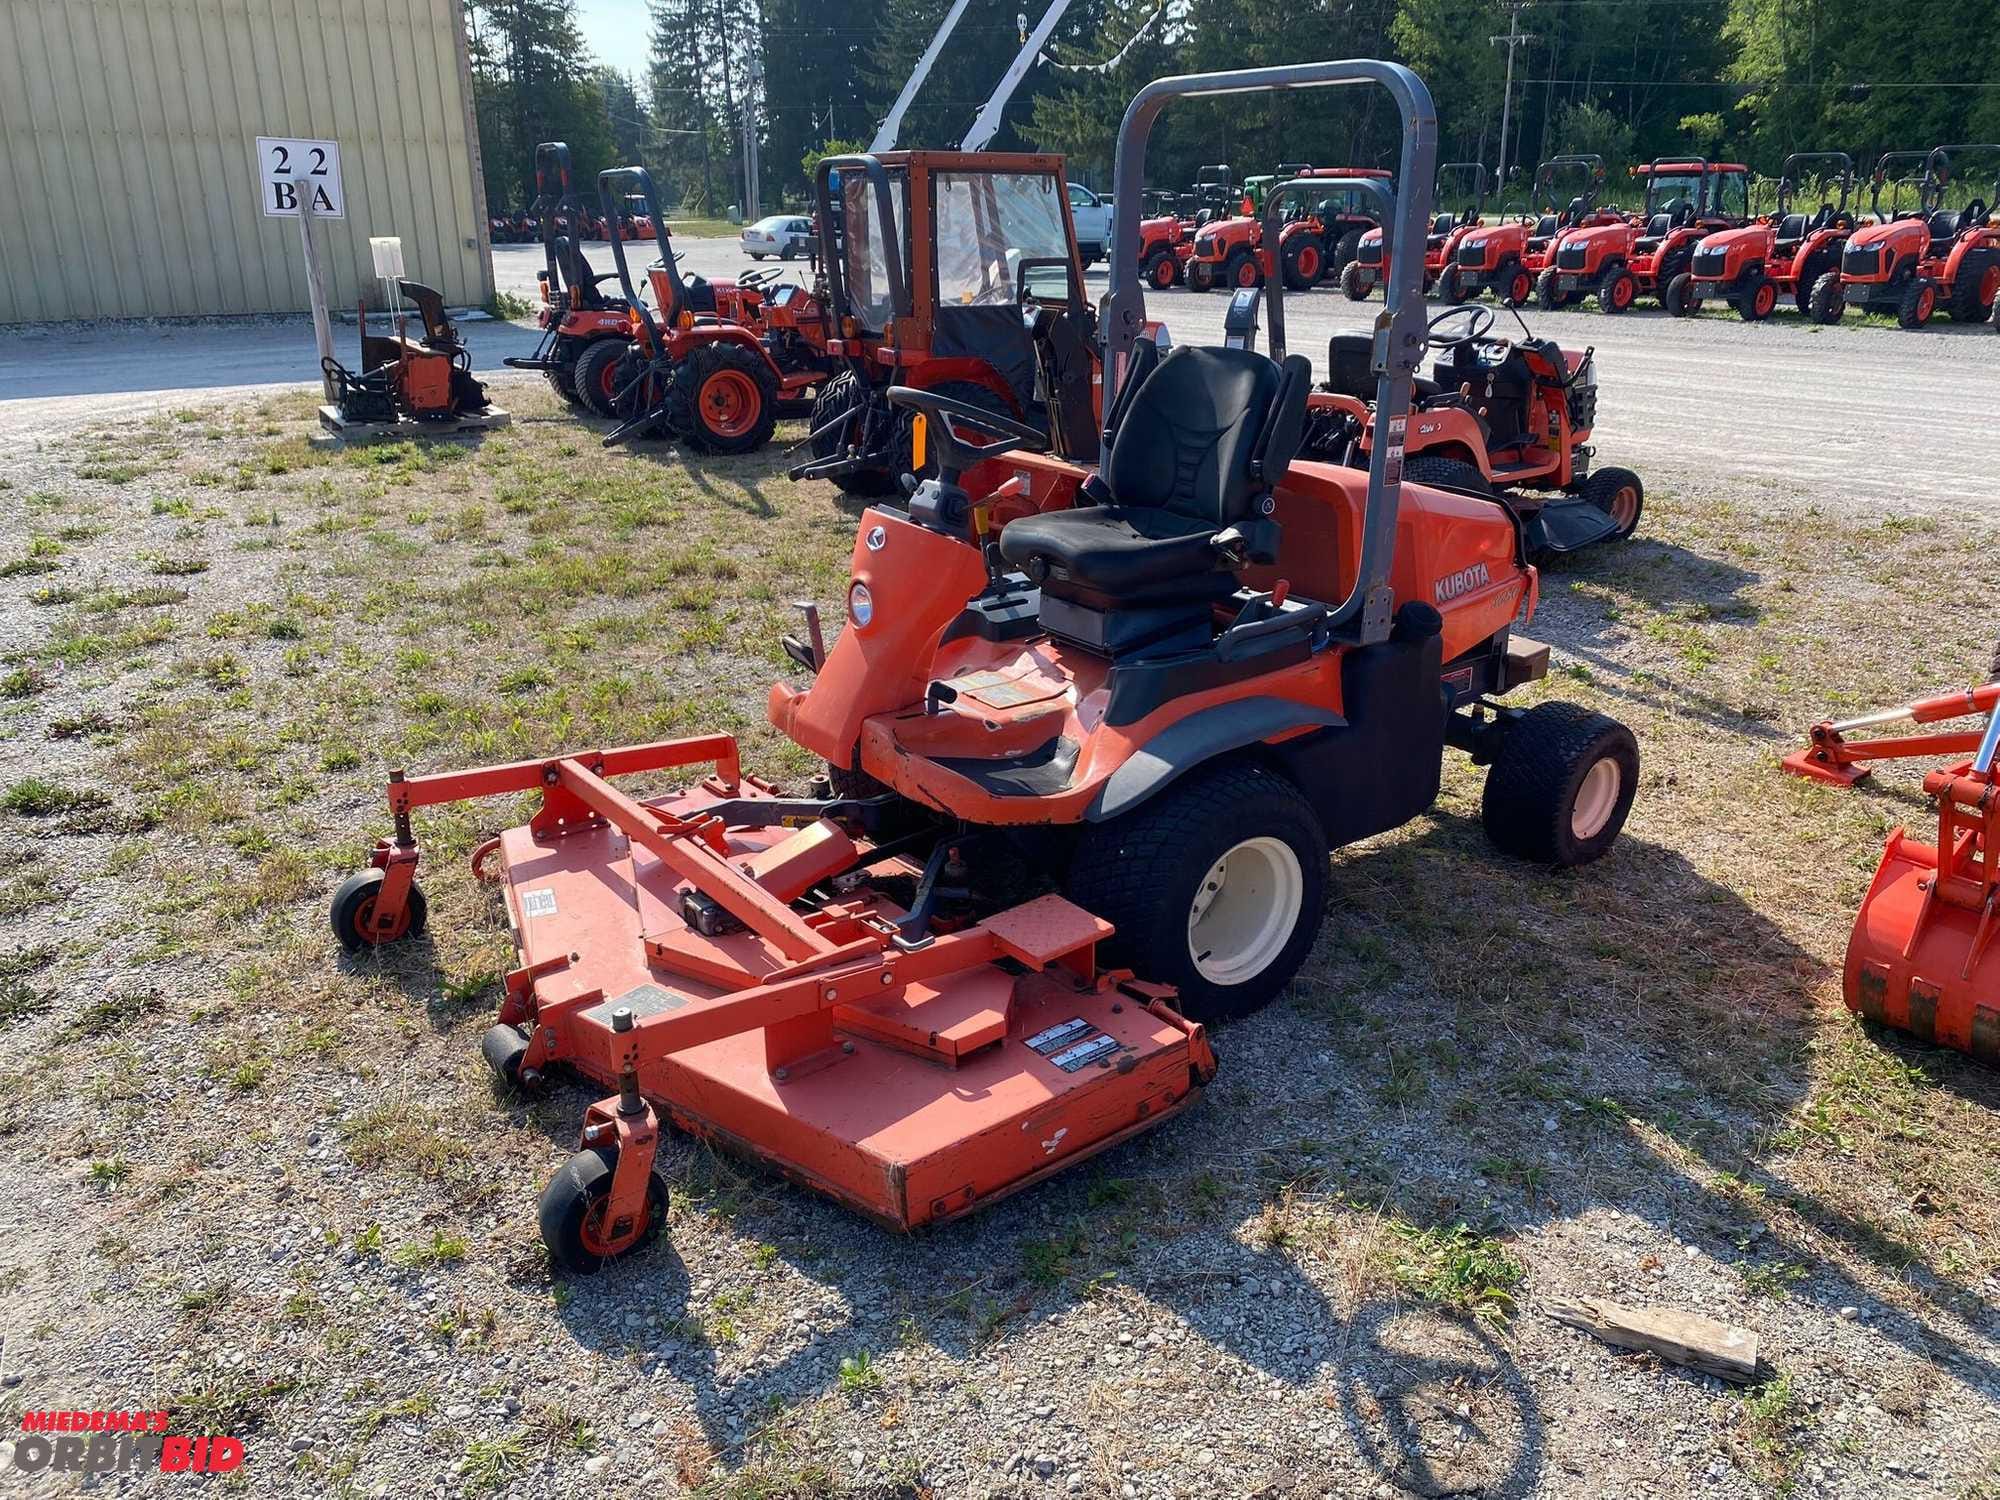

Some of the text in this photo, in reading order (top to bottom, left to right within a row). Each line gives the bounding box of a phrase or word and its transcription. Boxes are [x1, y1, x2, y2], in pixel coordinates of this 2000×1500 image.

[271, 146, 328, 175] 2 2
[271, 182, 336, 211] B A
[1434, 561, 1489, 603] KUBOTA
